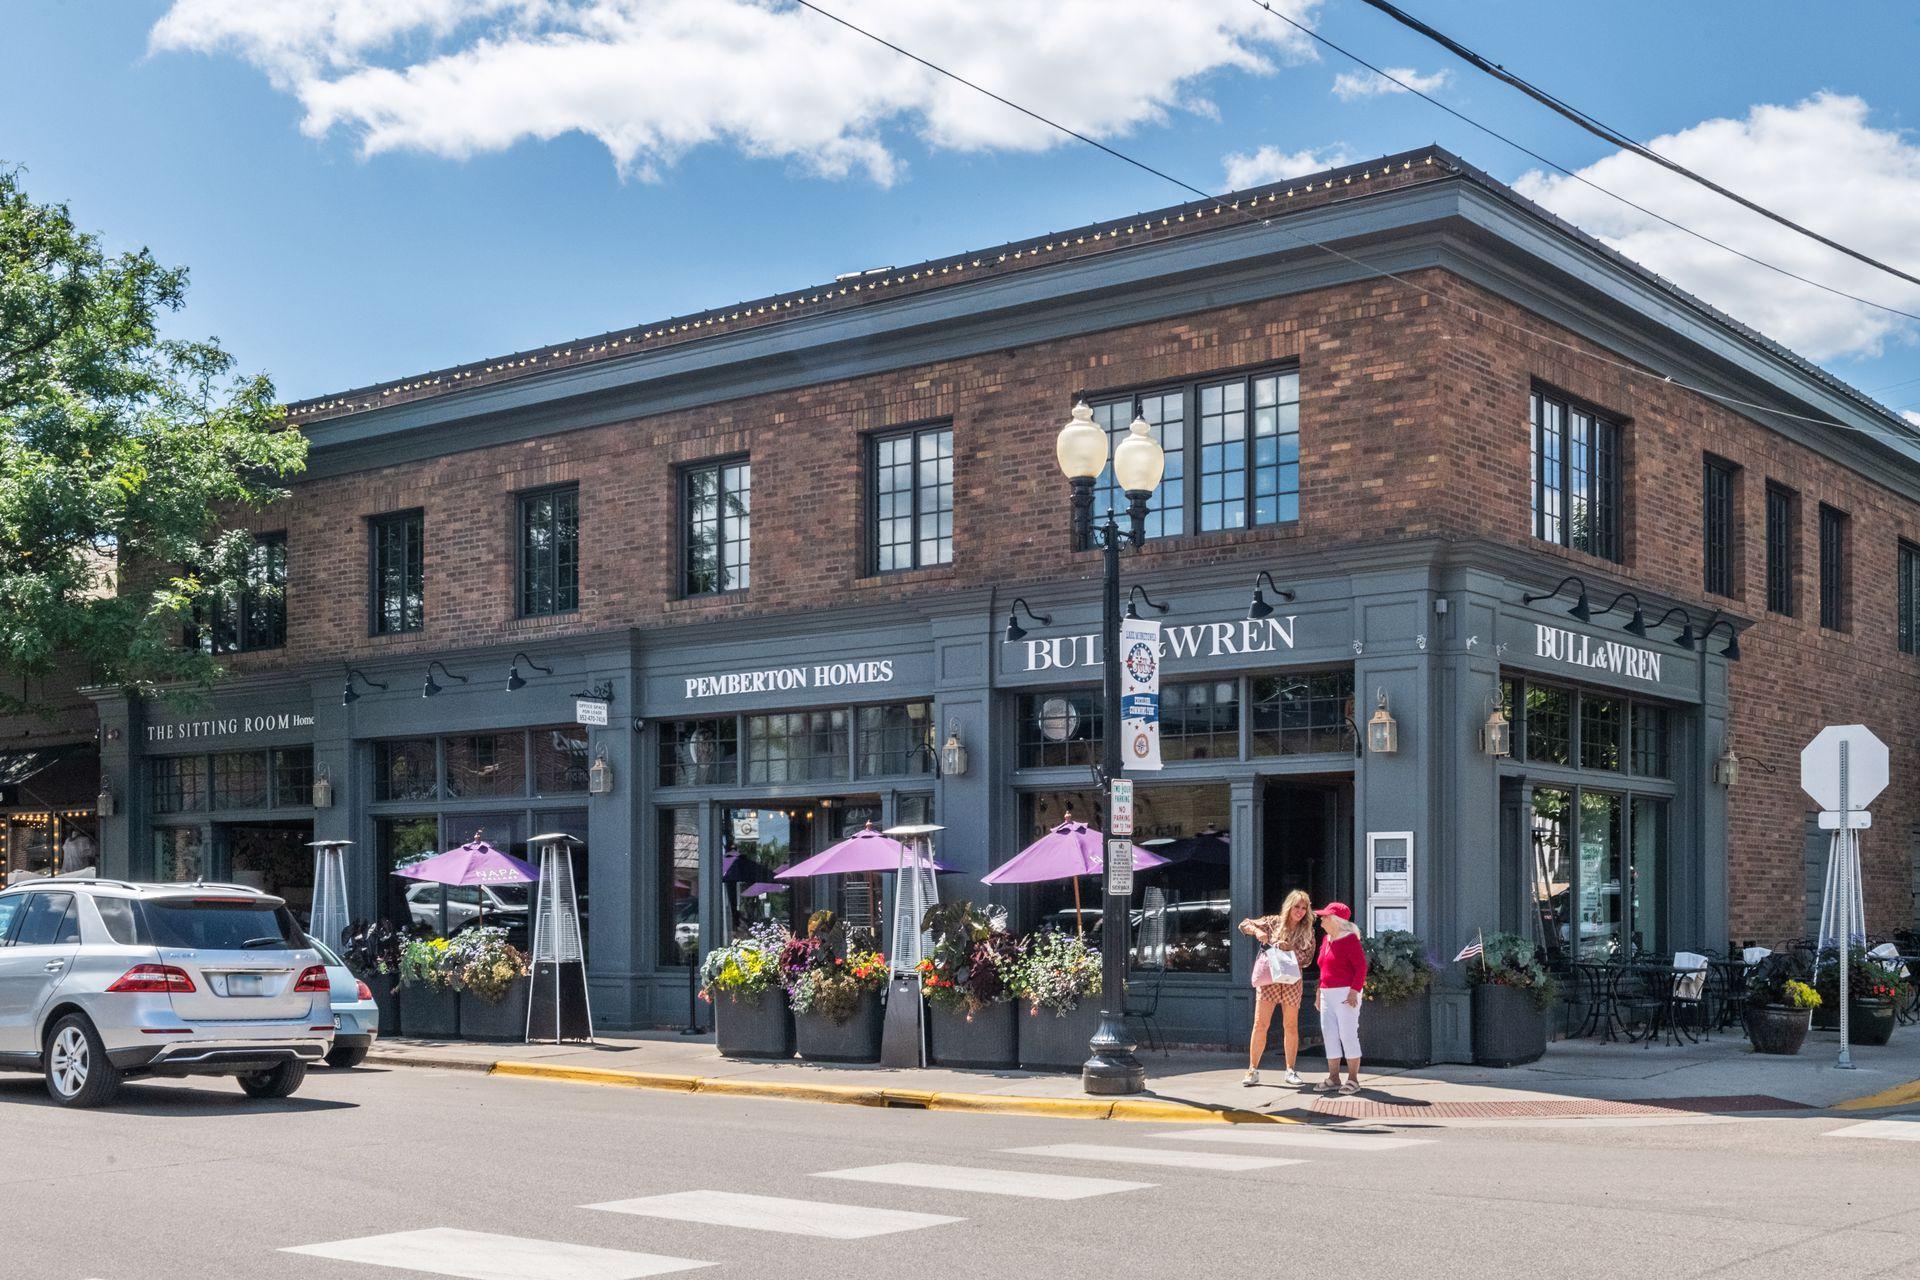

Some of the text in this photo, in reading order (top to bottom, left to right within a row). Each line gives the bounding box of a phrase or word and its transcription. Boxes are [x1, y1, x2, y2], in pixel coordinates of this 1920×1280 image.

[1534, 623, 1662, 682] BULL&WREN
[685, 660, 894, 699] PEMBERTON HOMES
[148, 724, 174, 741] THE
[179, 718, 238, 739] SITTING
[244, 714, 290, 733] ROOM
[1114, 795, 1130, 803] PARKING
[1119, 806, 1126, 814] NO
[1113, 814, 1131, 822] PARKING
[475, 868, 520, 877] NAPA
